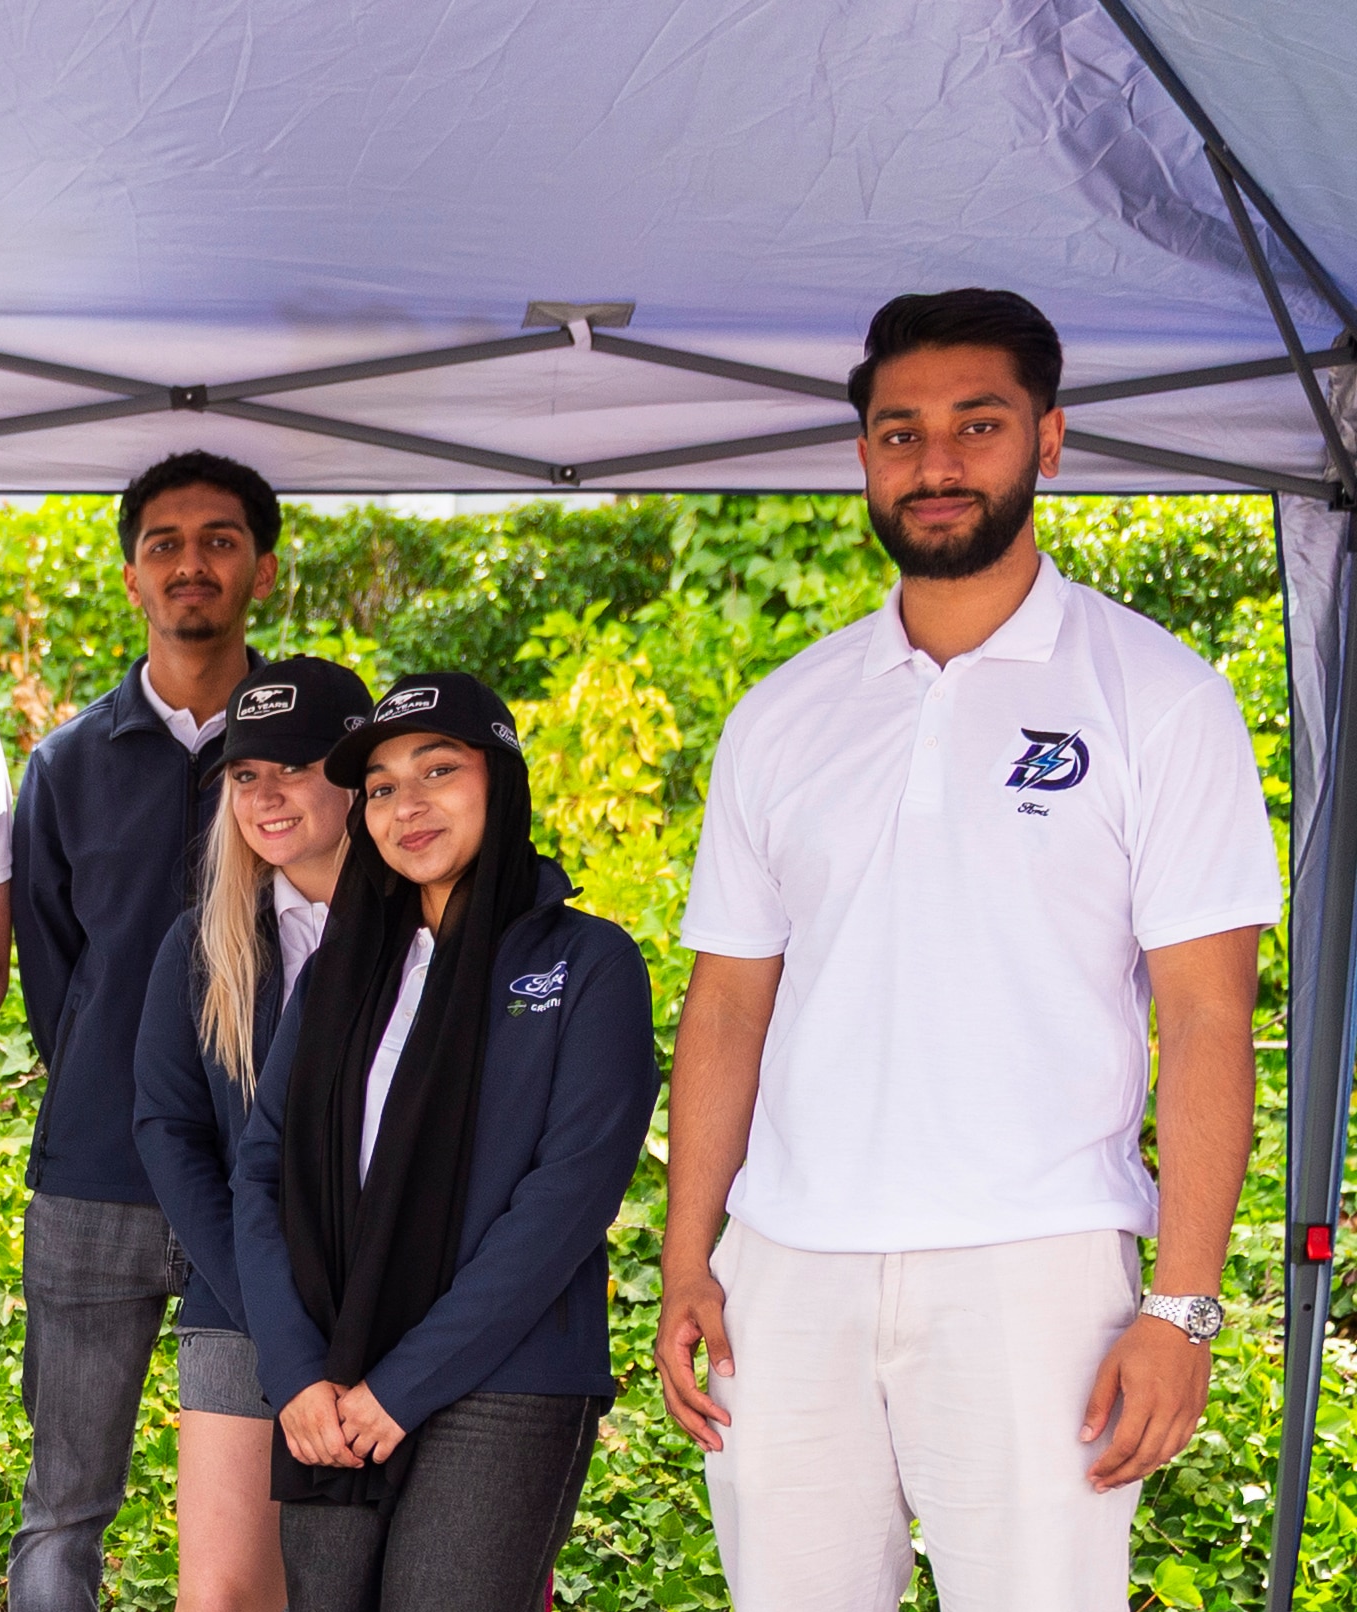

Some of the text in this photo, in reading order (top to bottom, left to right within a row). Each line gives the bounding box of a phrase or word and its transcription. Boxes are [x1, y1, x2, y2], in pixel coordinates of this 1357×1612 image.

[257, 701, 289, 711] YEARS
[395, 700, 430, 711] YEARS
[1017, 802, 1050, 817] Ford
